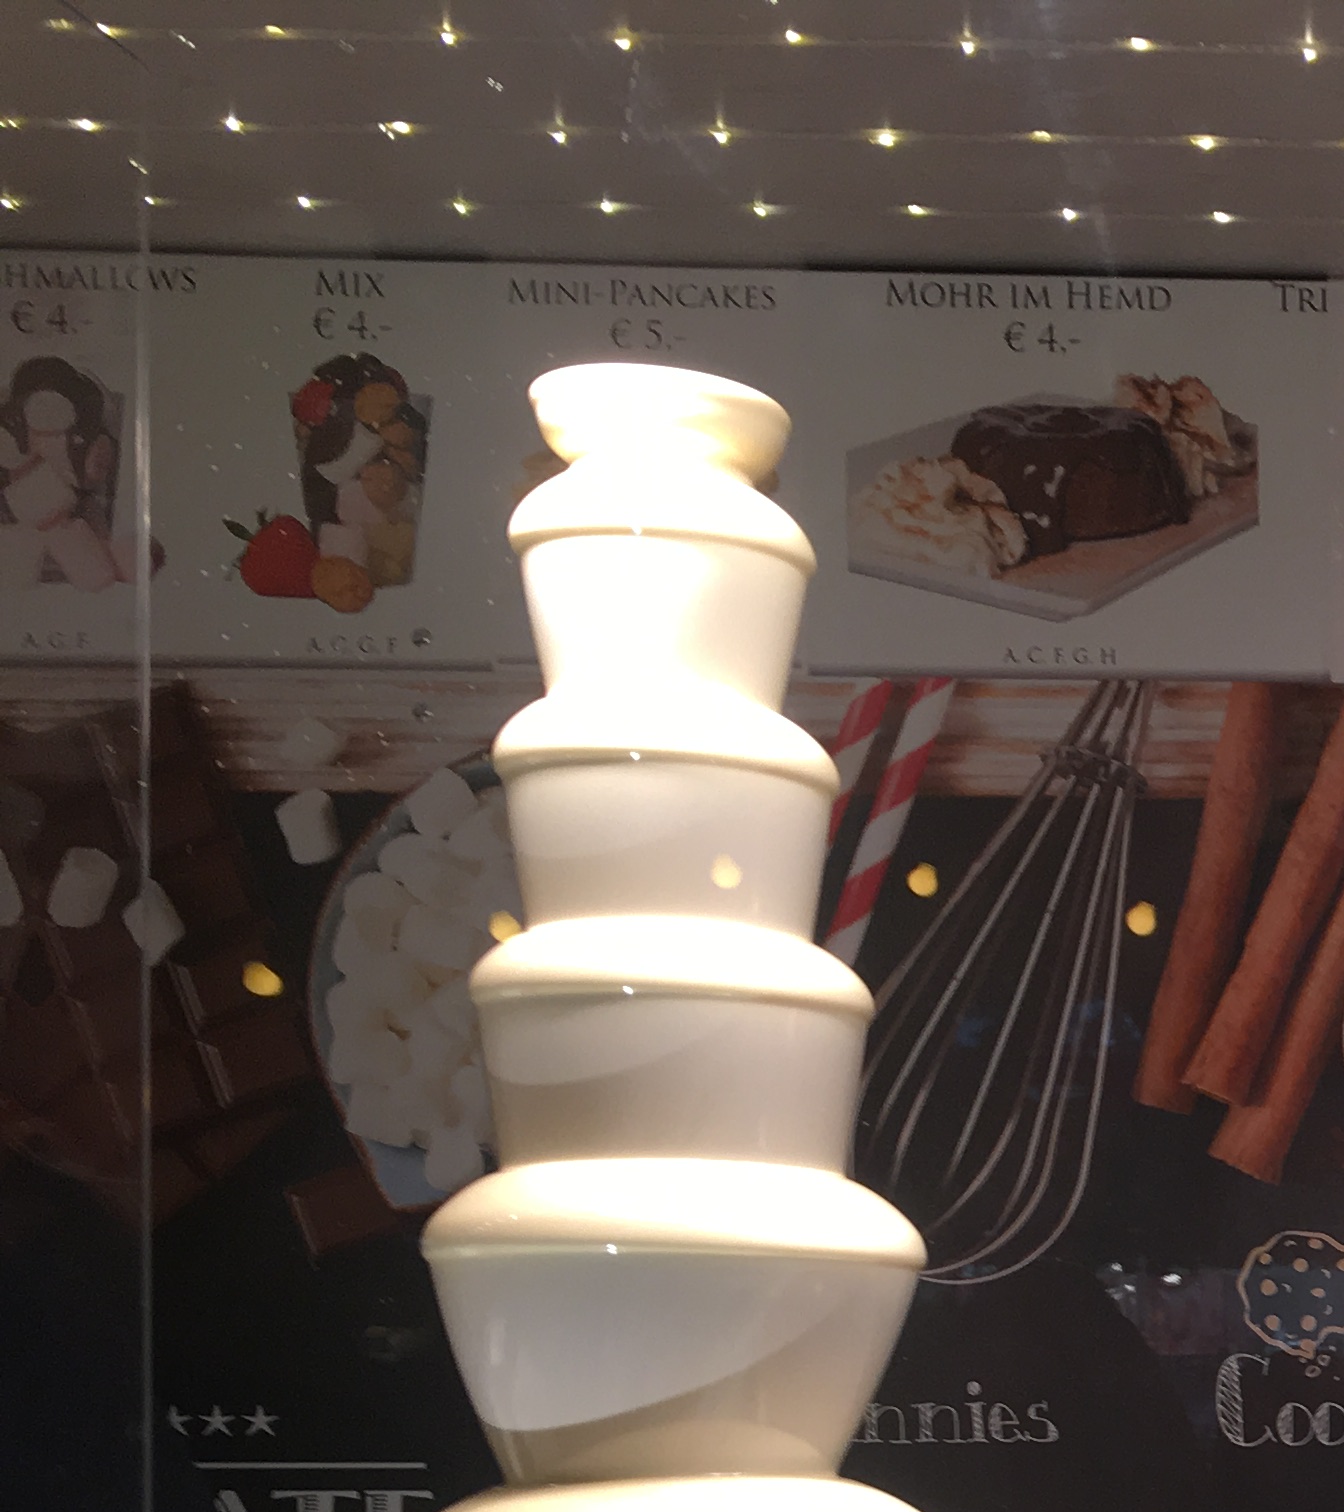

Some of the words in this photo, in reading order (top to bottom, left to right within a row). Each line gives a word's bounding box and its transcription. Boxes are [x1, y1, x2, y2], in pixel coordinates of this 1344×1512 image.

[314, 269, 386, 298] MIX
[507, 278, 778, 311] MINI-PANCAKES
[884, 278, 1000, 310] MOHR
[1010, 281, 1052, 311] IM
[1066, 280, 1173, 312] HEMD
[1274, 282, 1329, 313] TRI
[311, 306, 336, 340] €
[608, 318, 632, 350] €
[1003, 320, 1027, 353] €
